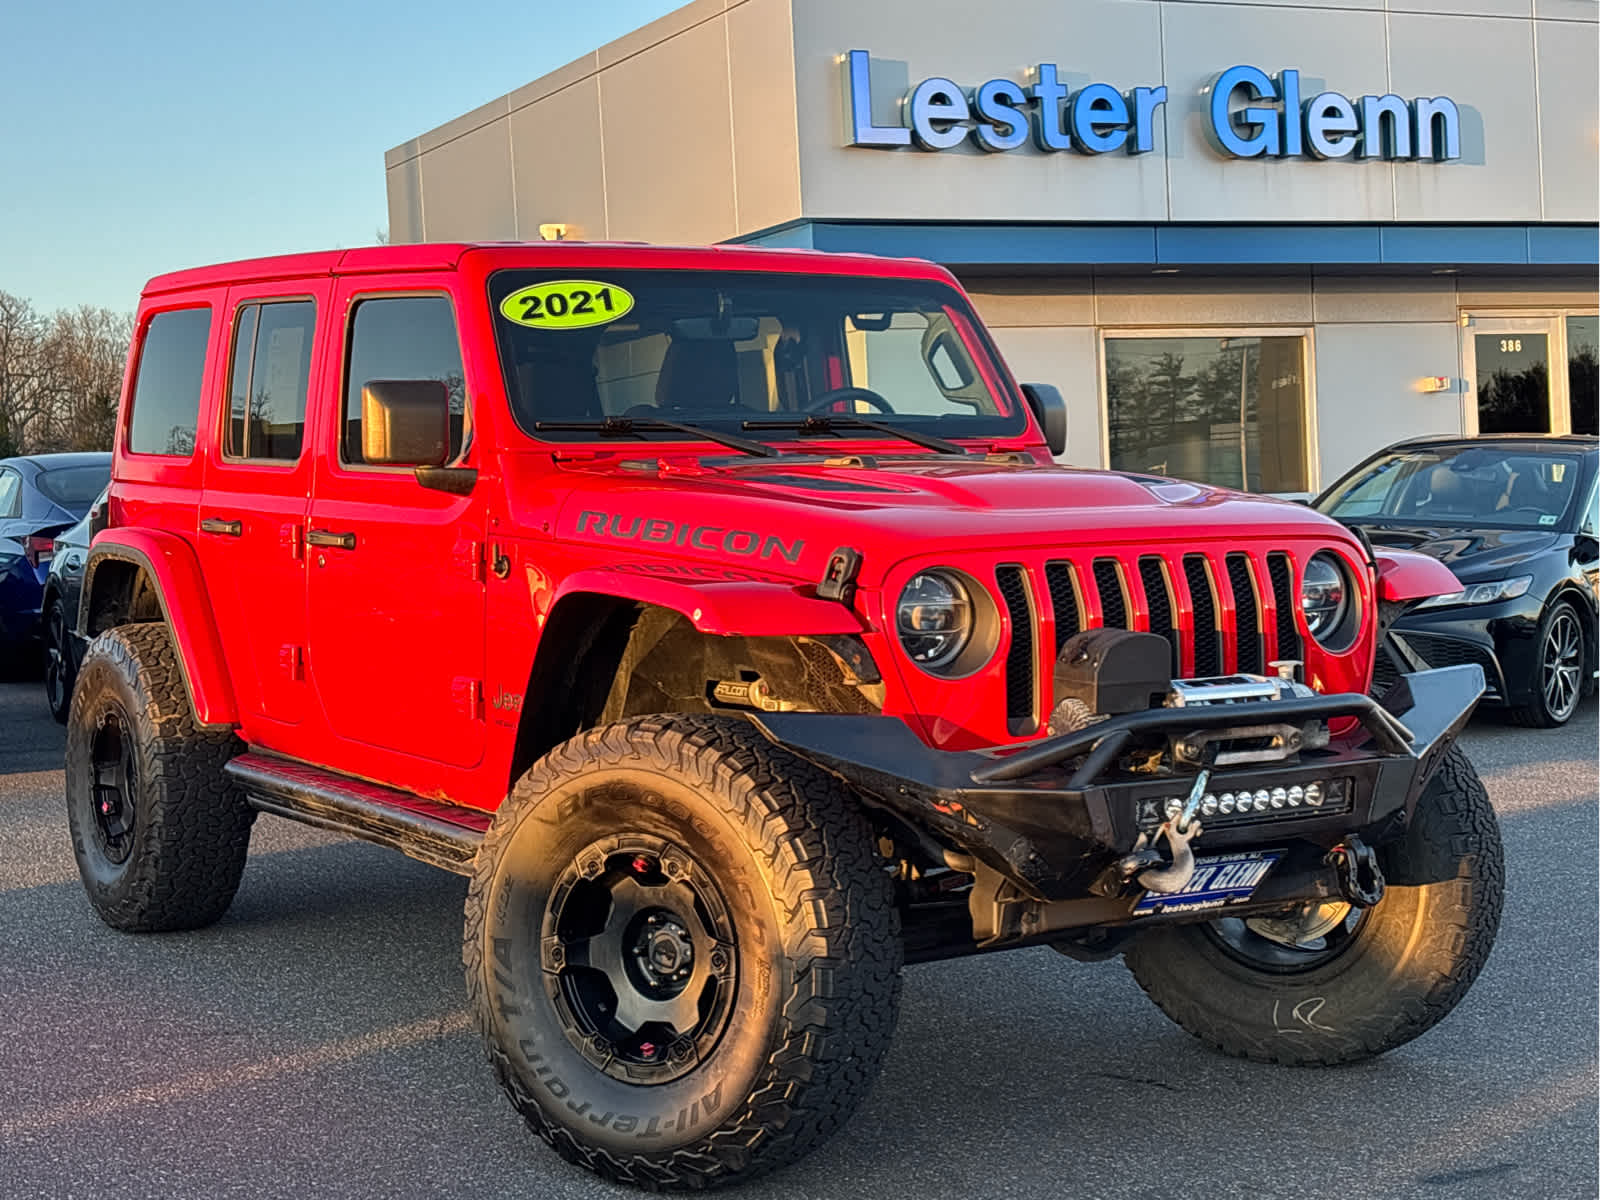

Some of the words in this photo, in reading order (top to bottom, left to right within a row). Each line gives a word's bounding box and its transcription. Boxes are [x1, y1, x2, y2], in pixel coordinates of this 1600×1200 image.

[845, 49, 1168, 153] Lester
[1208, 64, 1460, 160] Glenn
[519, 288, 614, 320] 2021
[1500, 340, 1521, 352] 386
[576, 511, 805, 563] RUBICON
[492, 684, 522, 711] Jee
[1209, 861, 1272, 890] GLENN
[519, 1039, 725, 1138] All-Terrain
